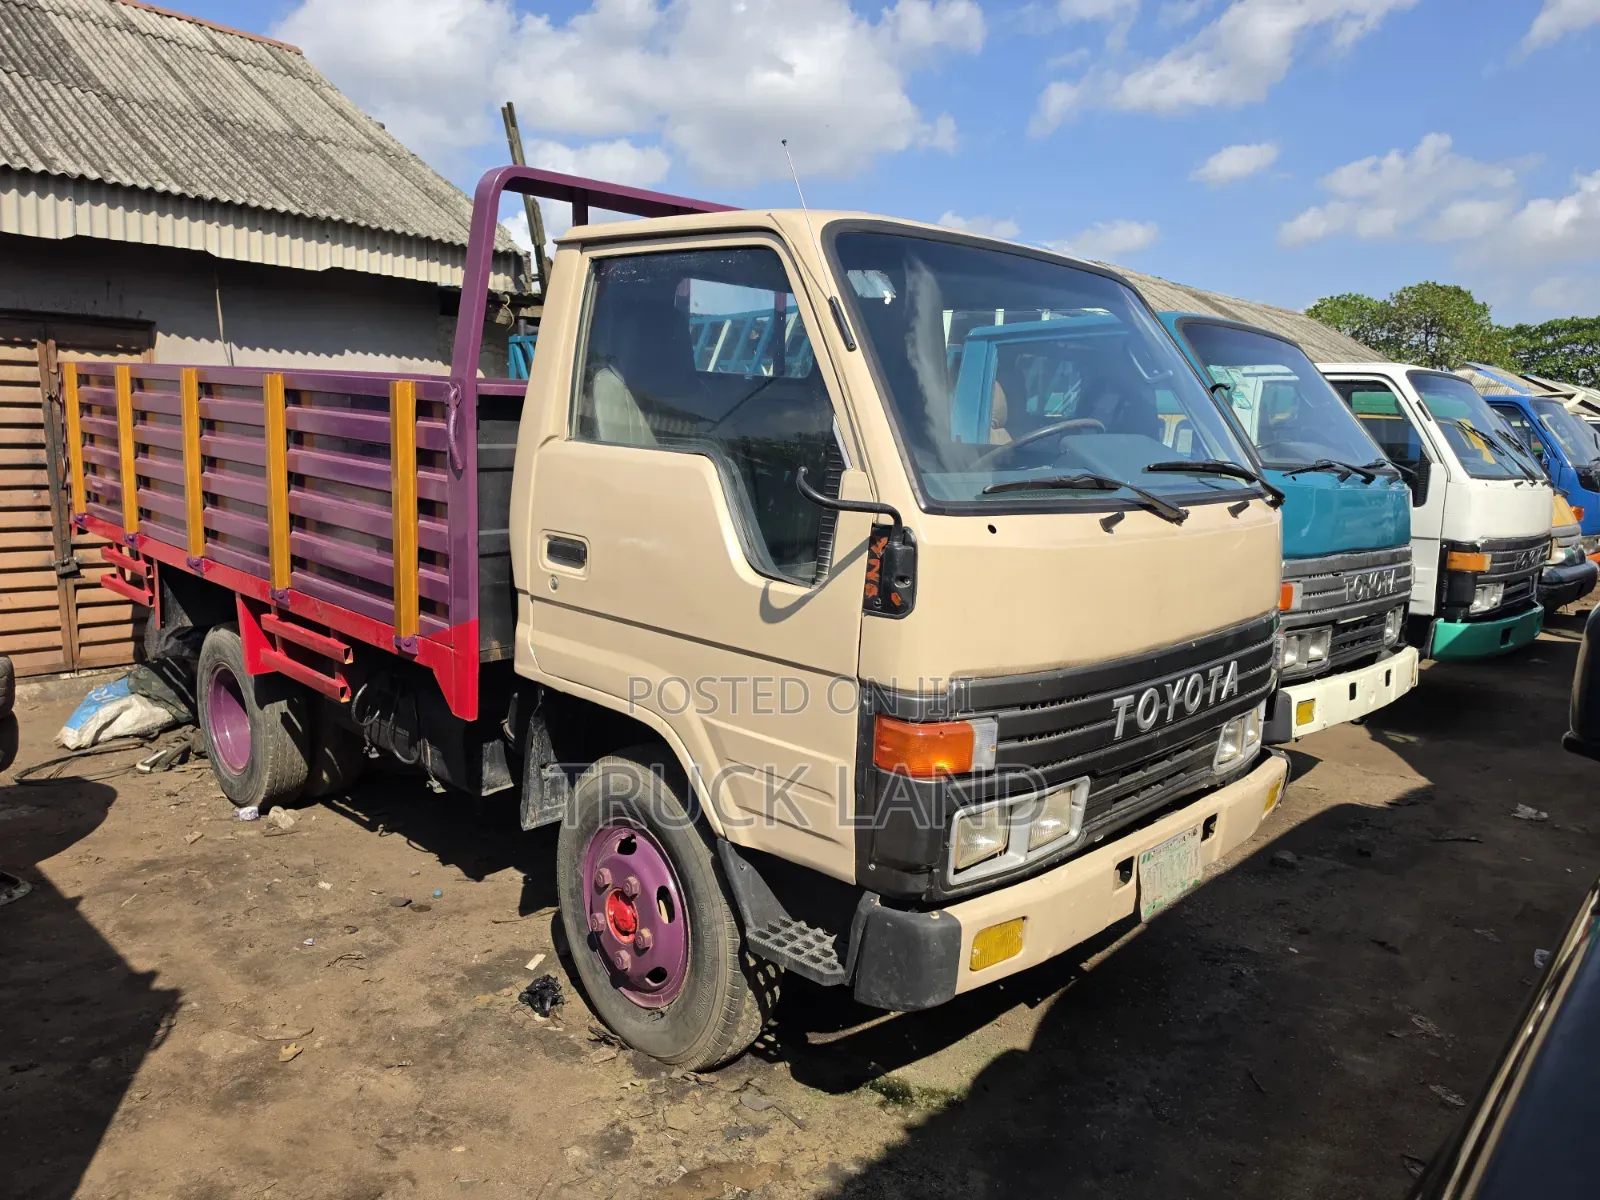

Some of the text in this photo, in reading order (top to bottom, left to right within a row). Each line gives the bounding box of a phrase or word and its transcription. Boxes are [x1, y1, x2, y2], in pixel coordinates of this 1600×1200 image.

[1343, 569, 1398, 603] TOYOTA
[1111, 660, 1238, 741] TOYOTA
[694, 979, 711, 1019] KING
